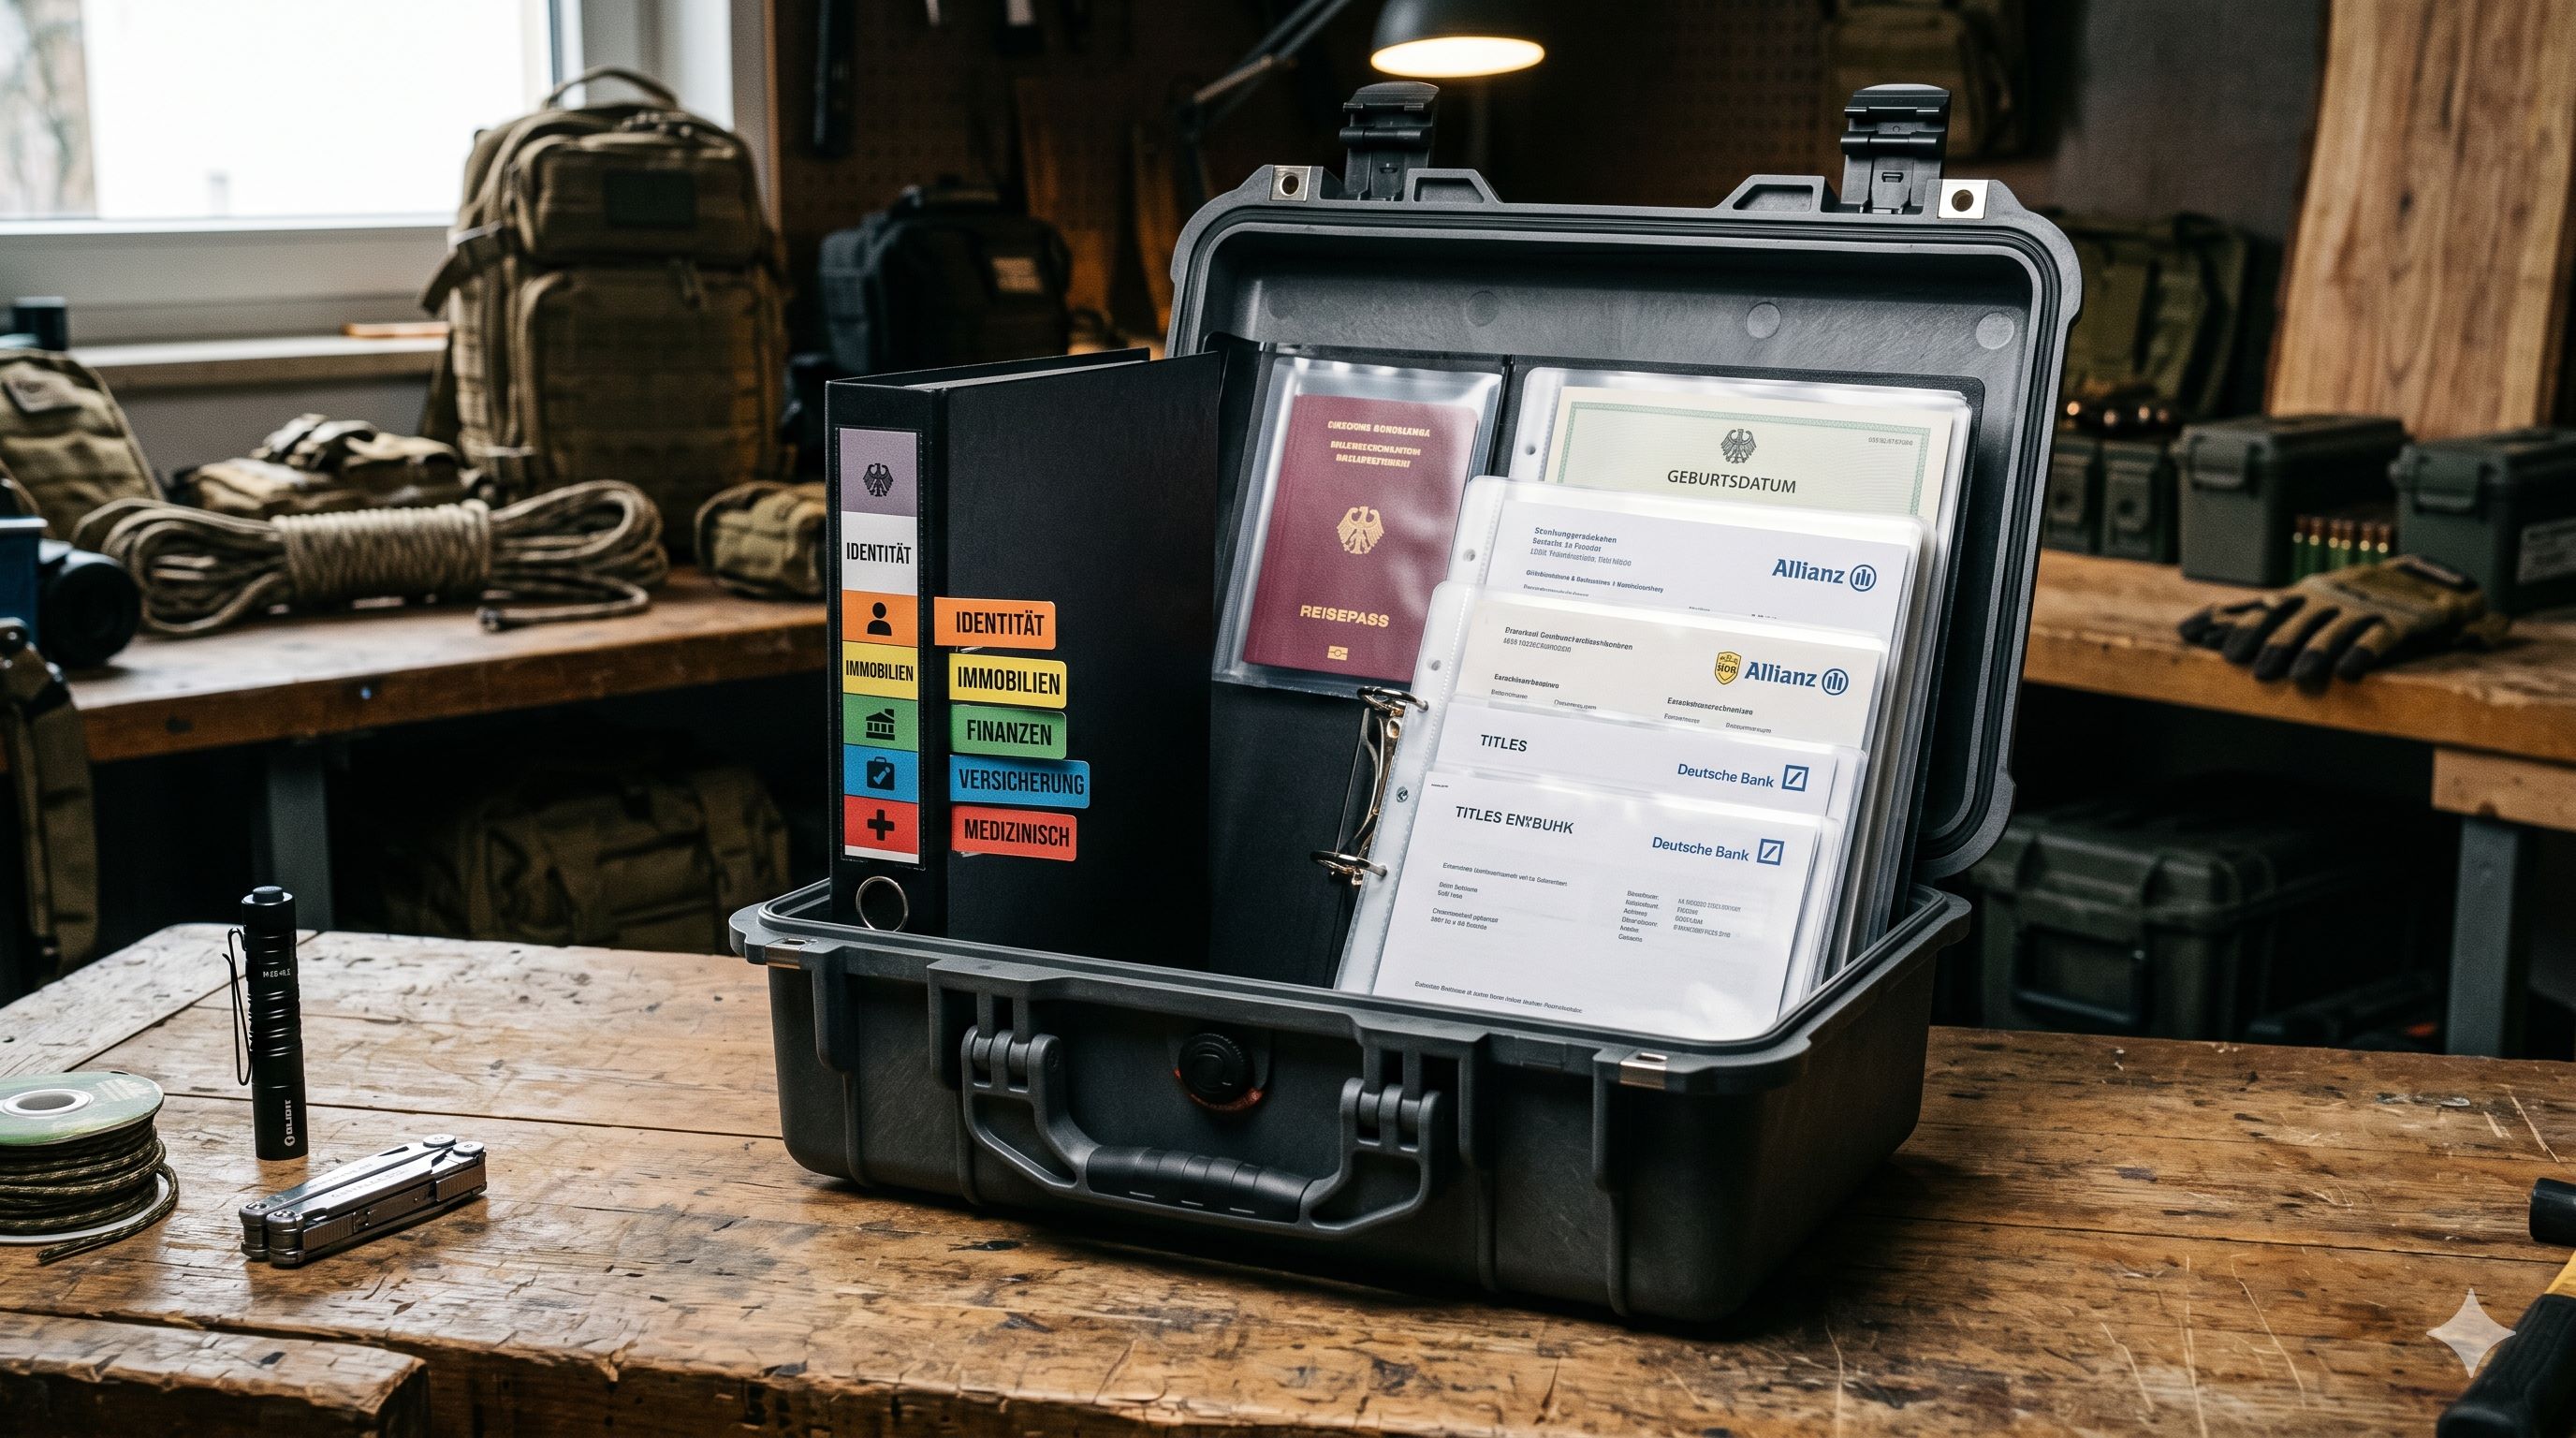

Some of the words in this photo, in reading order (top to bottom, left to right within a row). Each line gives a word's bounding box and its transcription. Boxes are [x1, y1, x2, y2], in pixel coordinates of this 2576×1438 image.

[1668, 470, 1795, 493] GEBURTSDATUM
[847, 542, 911, 564] IDENTITÄT
[1772, 559, 1845, 583] Allianz
[957, 610, 1044, 636] IDENTITÄT
[1300, 605, 1389, 627] REISEPASS
[846, 660, 913, 682] IMMOBILIEN
[959, 667, 1060, 695] IMMOBILIEN
[1745, 662, 1817, 687] Allianz
[968, 719, 1051, 745] FINANZEN
[1481, 735, 1527, 752] TITLES
[959, 769, 1084, 795] VERSICHERUNG
[1678, 764, 1737, 782] Deutsche
[1741, 772, 1774, 787] Bank
[1456, 806, 1501, 823] TITLES
[965, 819, 1069, 846] MEDIZINISCH
[1652, 837, 1712, 856] Deutsche
[1716, 846, 1749, 861] Bank
